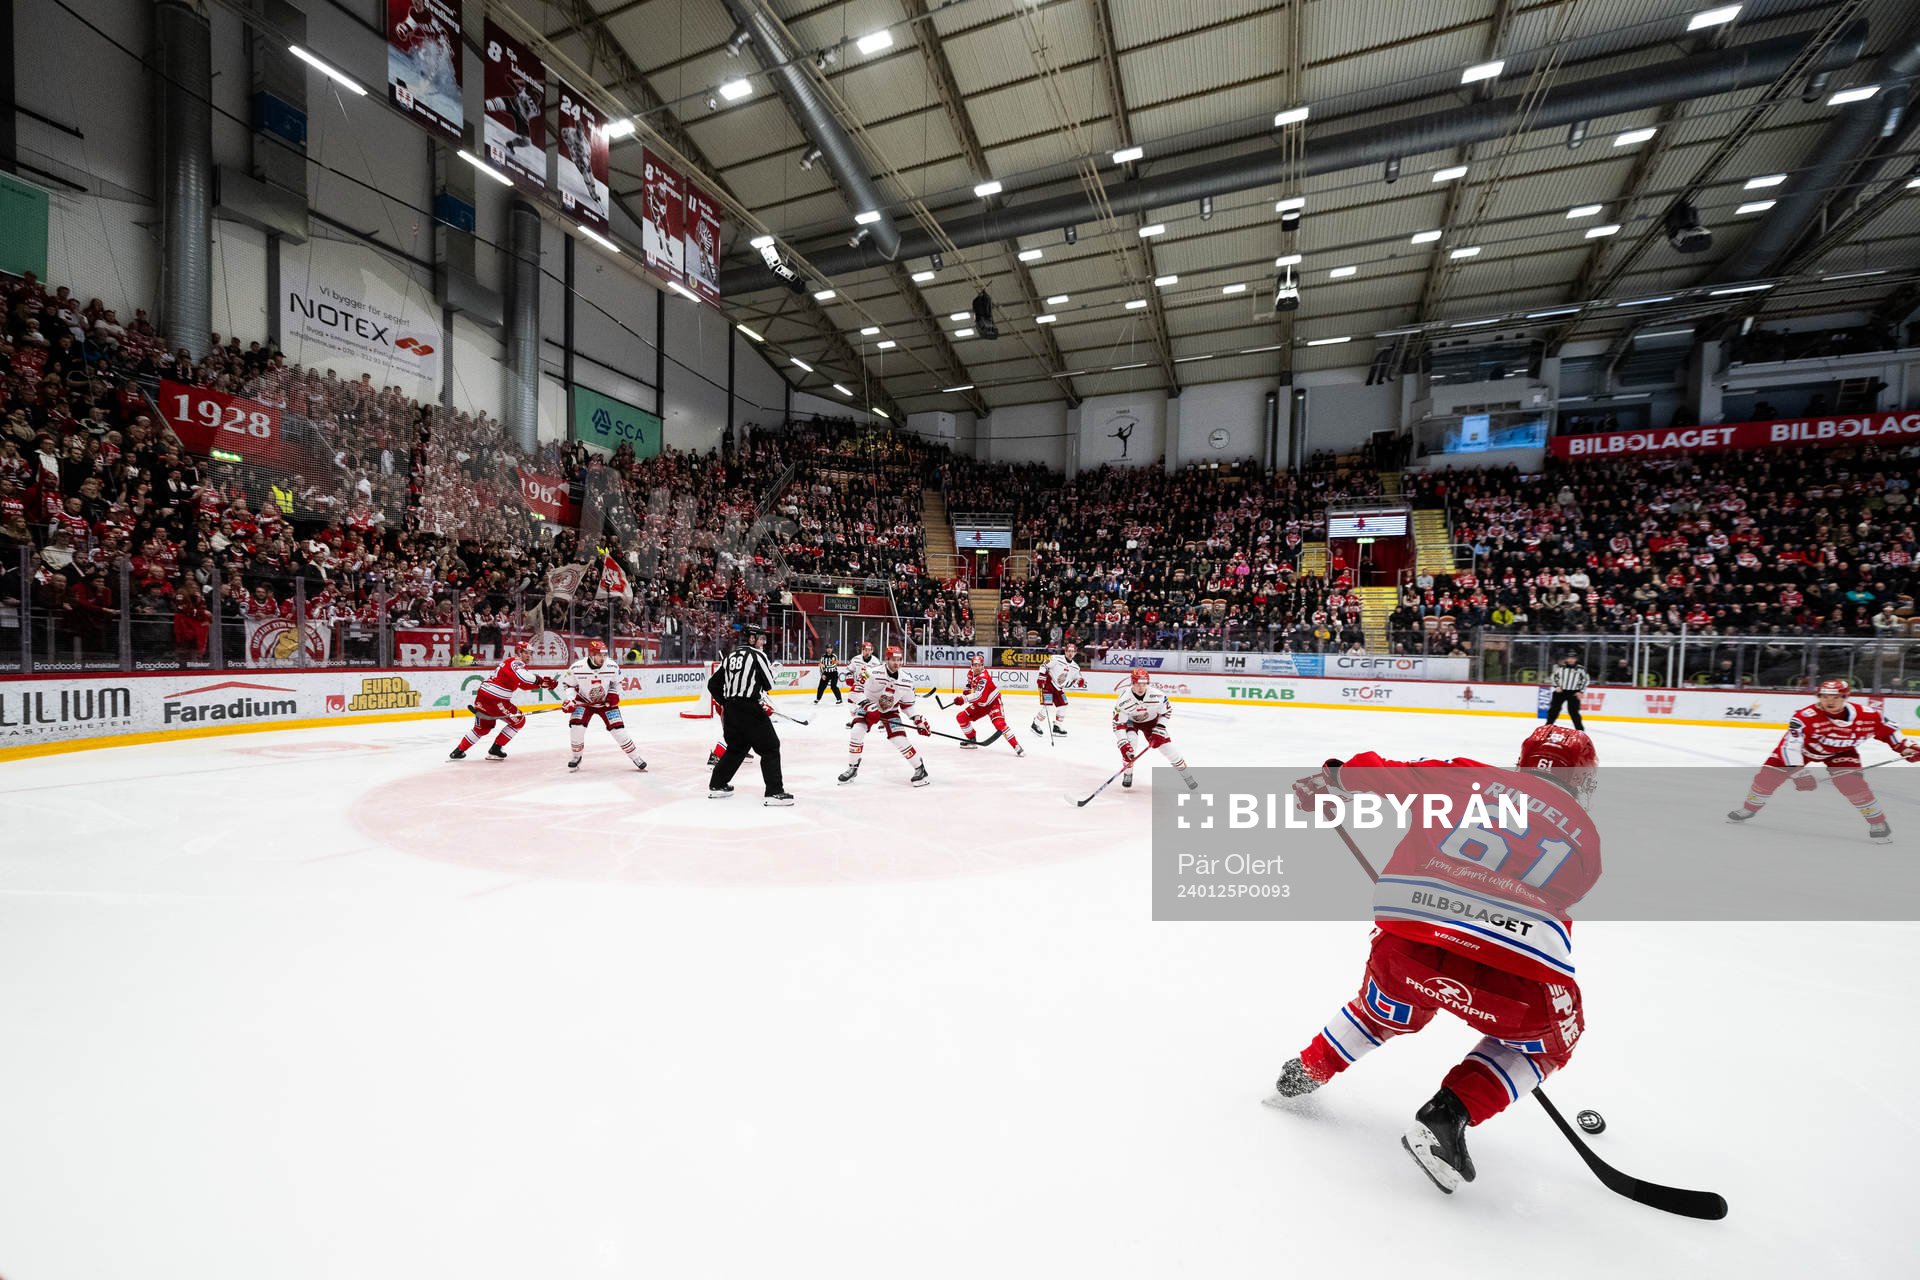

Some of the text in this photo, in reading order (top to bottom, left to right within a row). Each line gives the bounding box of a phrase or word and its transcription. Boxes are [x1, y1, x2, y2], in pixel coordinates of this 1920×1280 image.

[488, 41, 502, 63] 8
[560, 94, 580, 121] 24
[644, 163, 654, 181] 8
[319, 285, 329, 297] Vi
[332, 290, 367, 309] bygger
[368, 304, 380, 316] för
[290, 292, 389, 346] NOTEX
[173, 394, 271, 438] 1928
[615, 420, 644, 443] SCA
[1570, 427, 1736, 456] BILBOLAGET
[34, 661, 82, 670] Brandcode
[136, 661, 180, 669] Brandcode
[729, 655, 743, 671] 88
[1103, 655, 1132, 667] L&S
[1225, 656, 1246, 668] HH
[362, 677, 403, 694] EURO
[1227, 686, 1295, 700] TIRAB
[164, 698, 297, 724] Faradium
[348, 690, 419, 712] JACKPOT
[1537, 759, 1553, 772] 61
[1439, 803, 1573, 890] 61
[1489, 876, 1514, 893] with
[1411, 891, 1534, 937] BILBOLAGET
[1406, 977, 1498, 1023] PROLYMPIA
